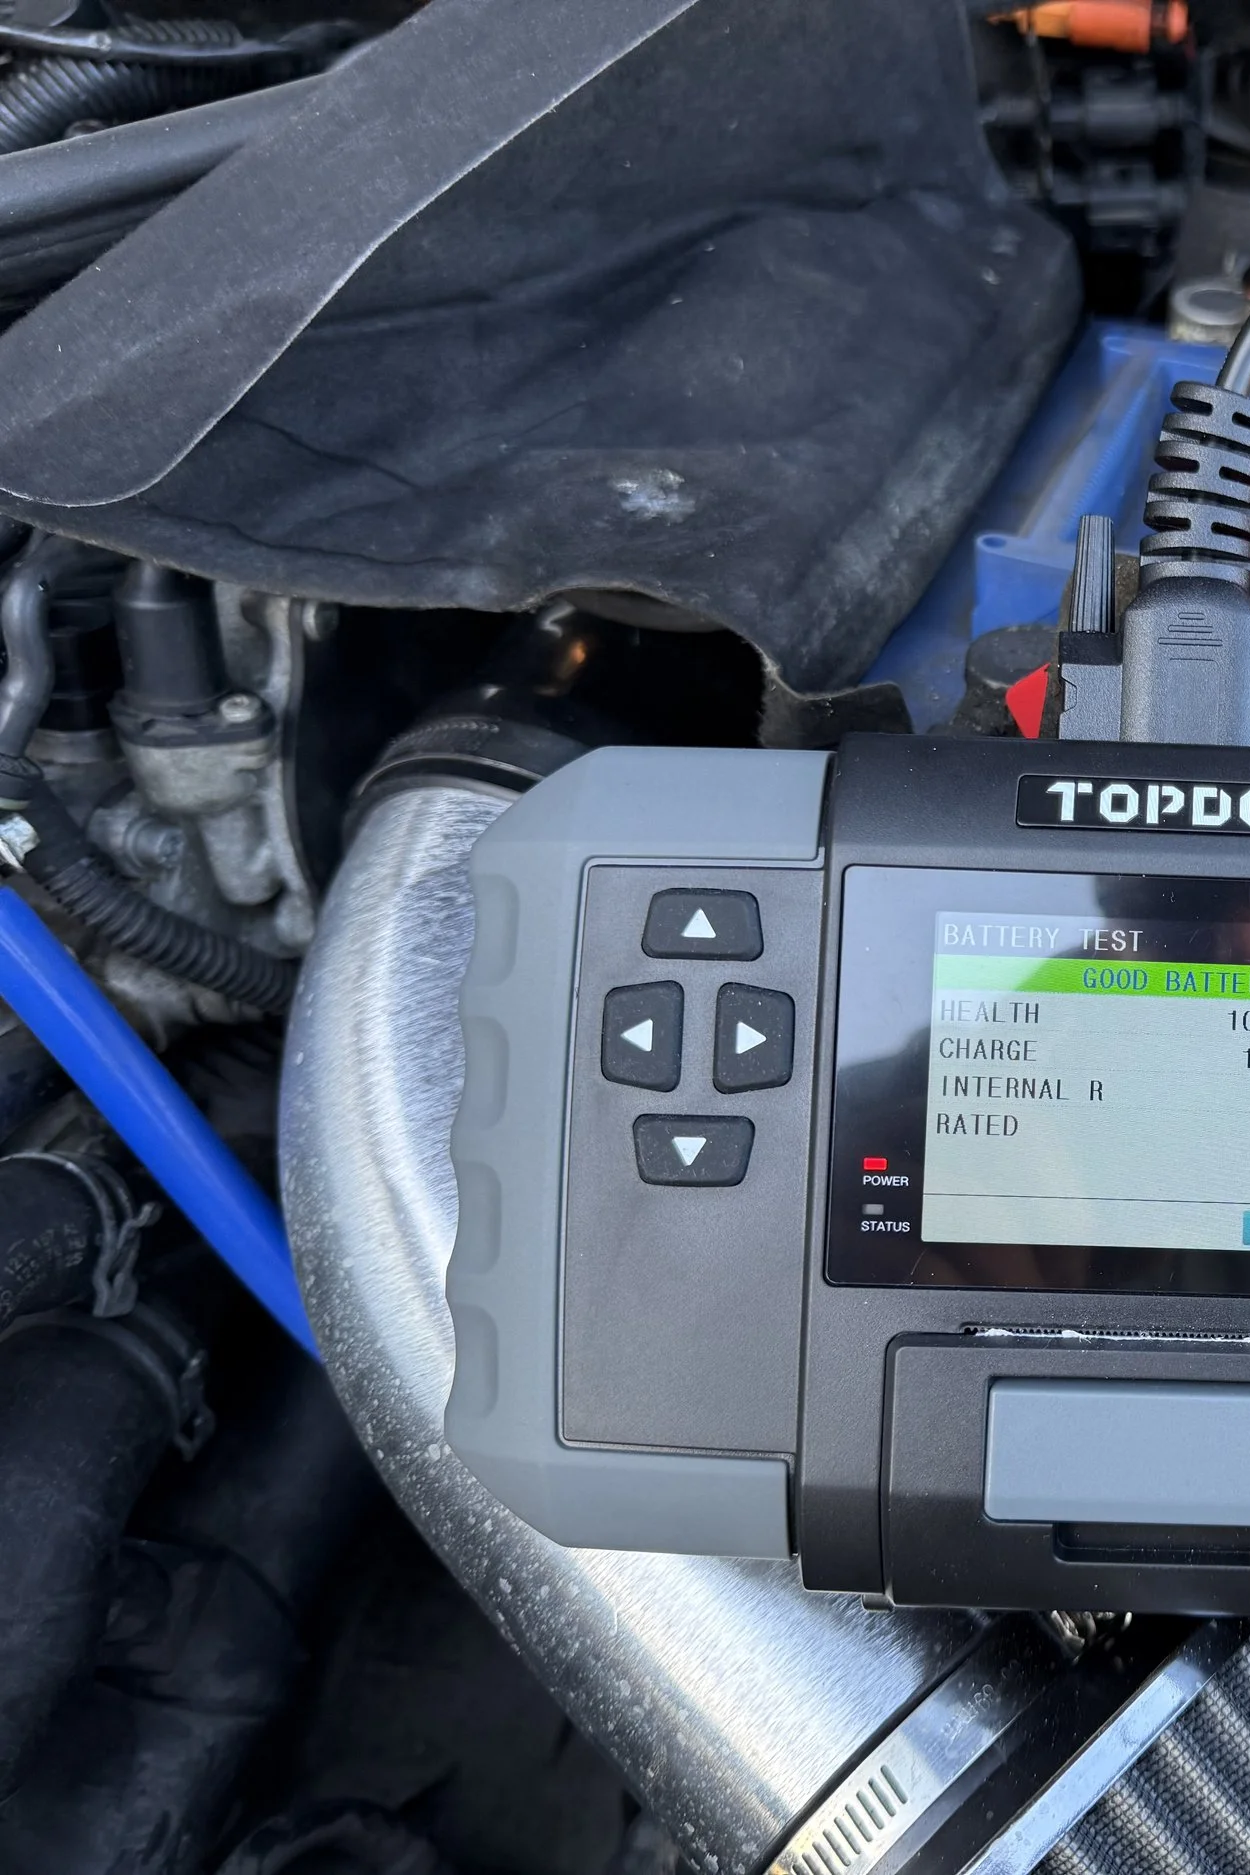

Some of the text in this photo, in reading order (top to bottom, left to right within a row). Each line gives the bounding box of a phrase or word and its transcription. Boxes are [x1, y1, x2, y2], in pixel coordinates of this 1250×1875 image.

[944, 923, 1144, 952] BATTERY TEST
[1083, 967, 1148, 990] GOOD
[941, 999, 1040, 1024] HEALTH
[939, 1037, 1038, 1062] CHARGE
[942, 1075, 1070, 1101] INTERNAL
[1089, 1080, 1104, 1101] R
[936, 1113, 1019, 1137] RATED
[863, 1175, 910, 1187] POWER
[861, 1220, 911, 1233] STATUS
